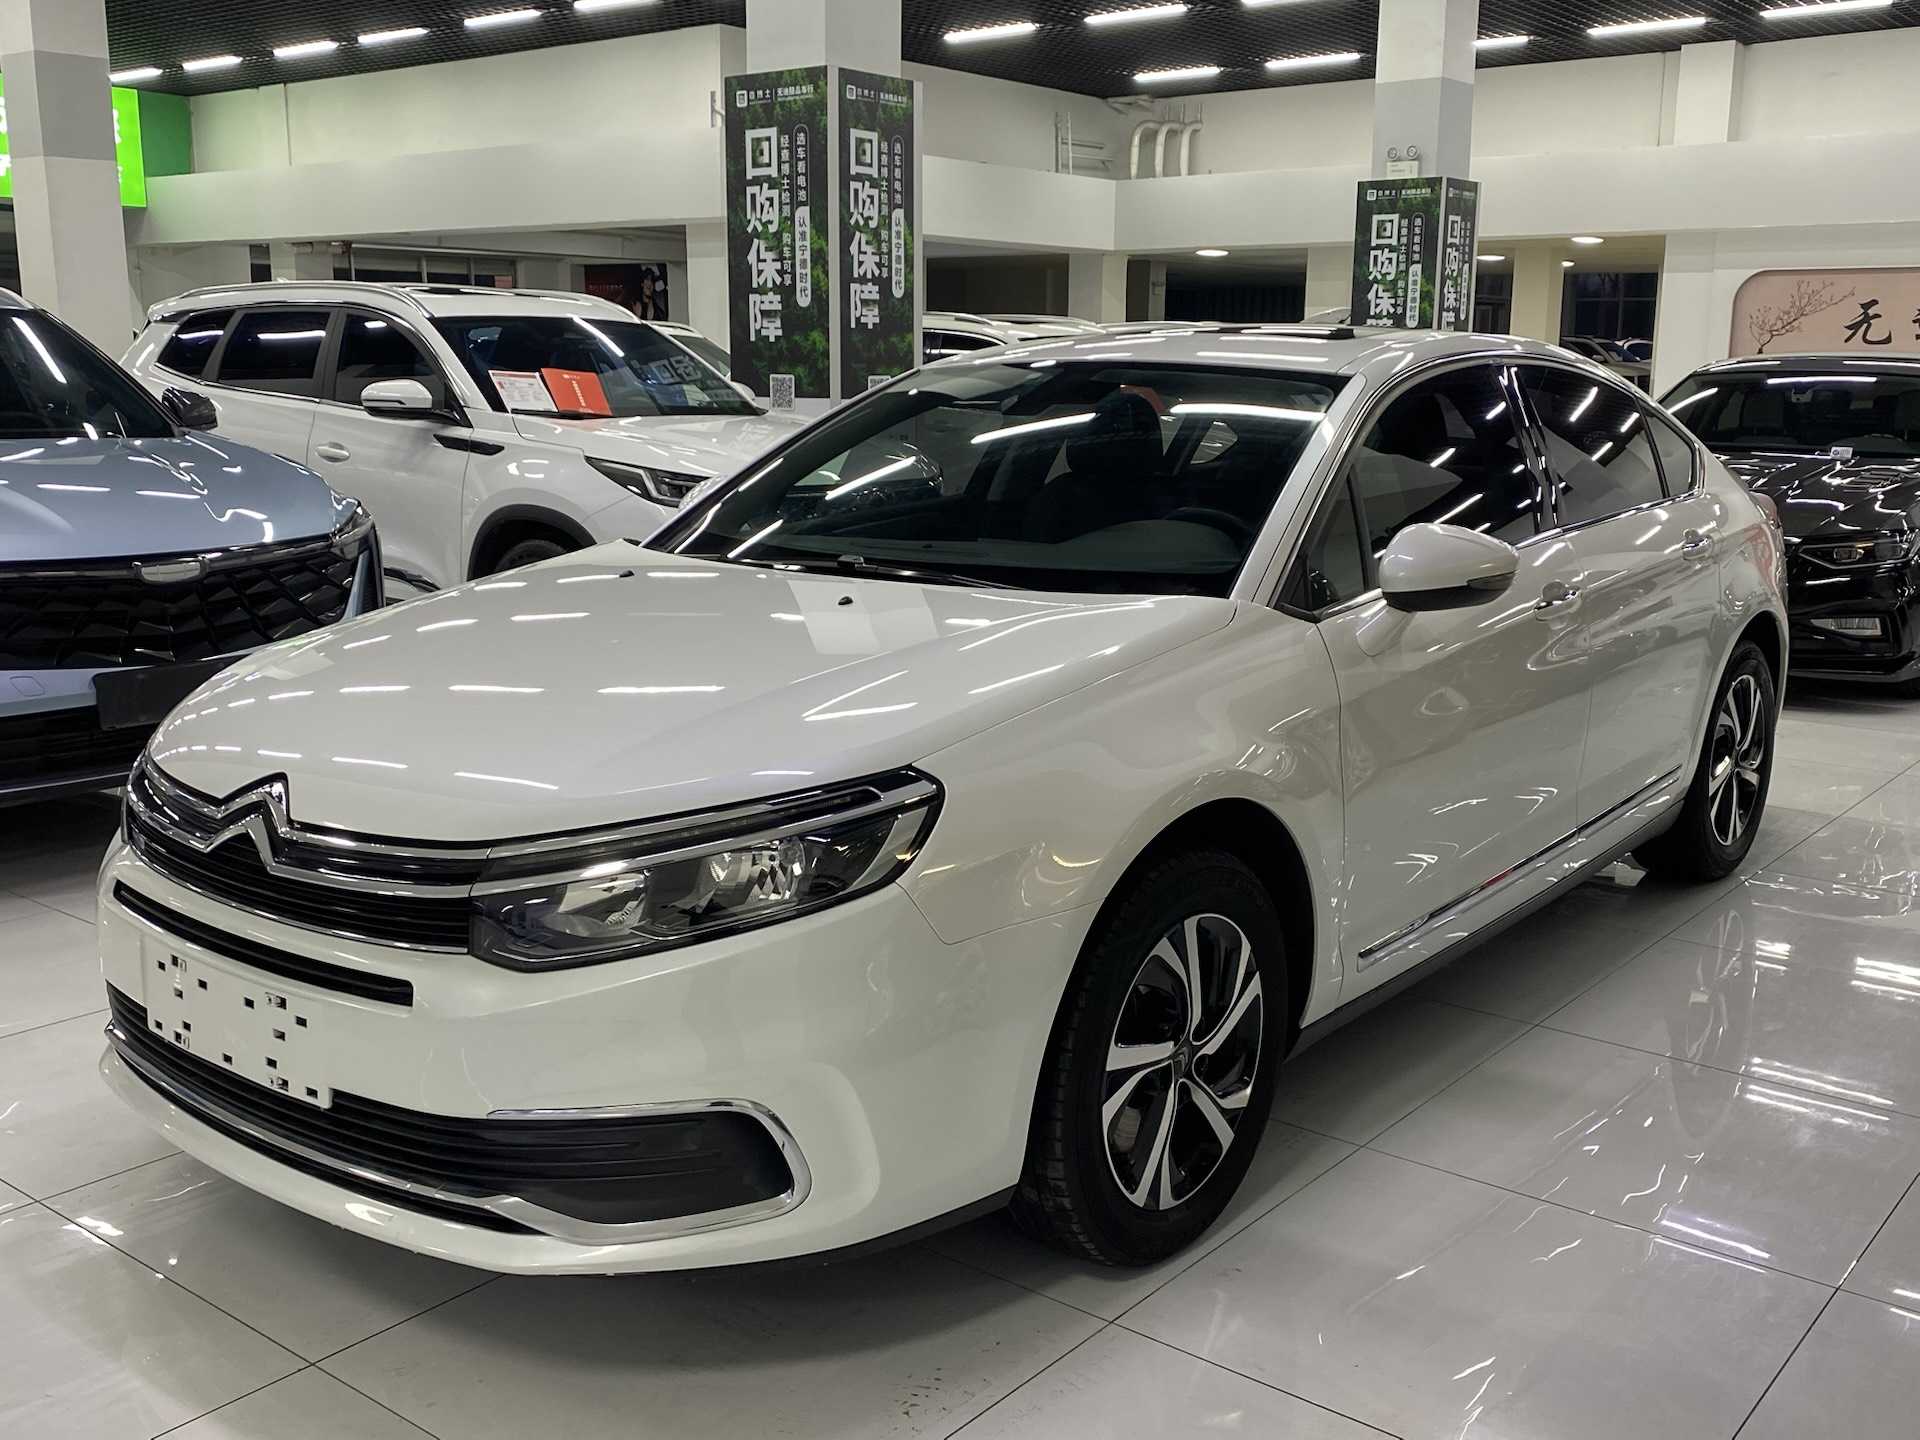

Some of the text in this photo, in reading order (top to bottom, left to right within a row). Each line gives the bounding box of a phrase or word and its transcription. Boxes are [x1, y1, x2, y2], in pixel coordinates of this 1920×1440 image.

[745, 127, 783, 342] 回购保障
[850, 128, 880, 329] 回购保障
[1366, 213, 1400, 327] 回购保
[1844, 299, 1920, 346] 无
